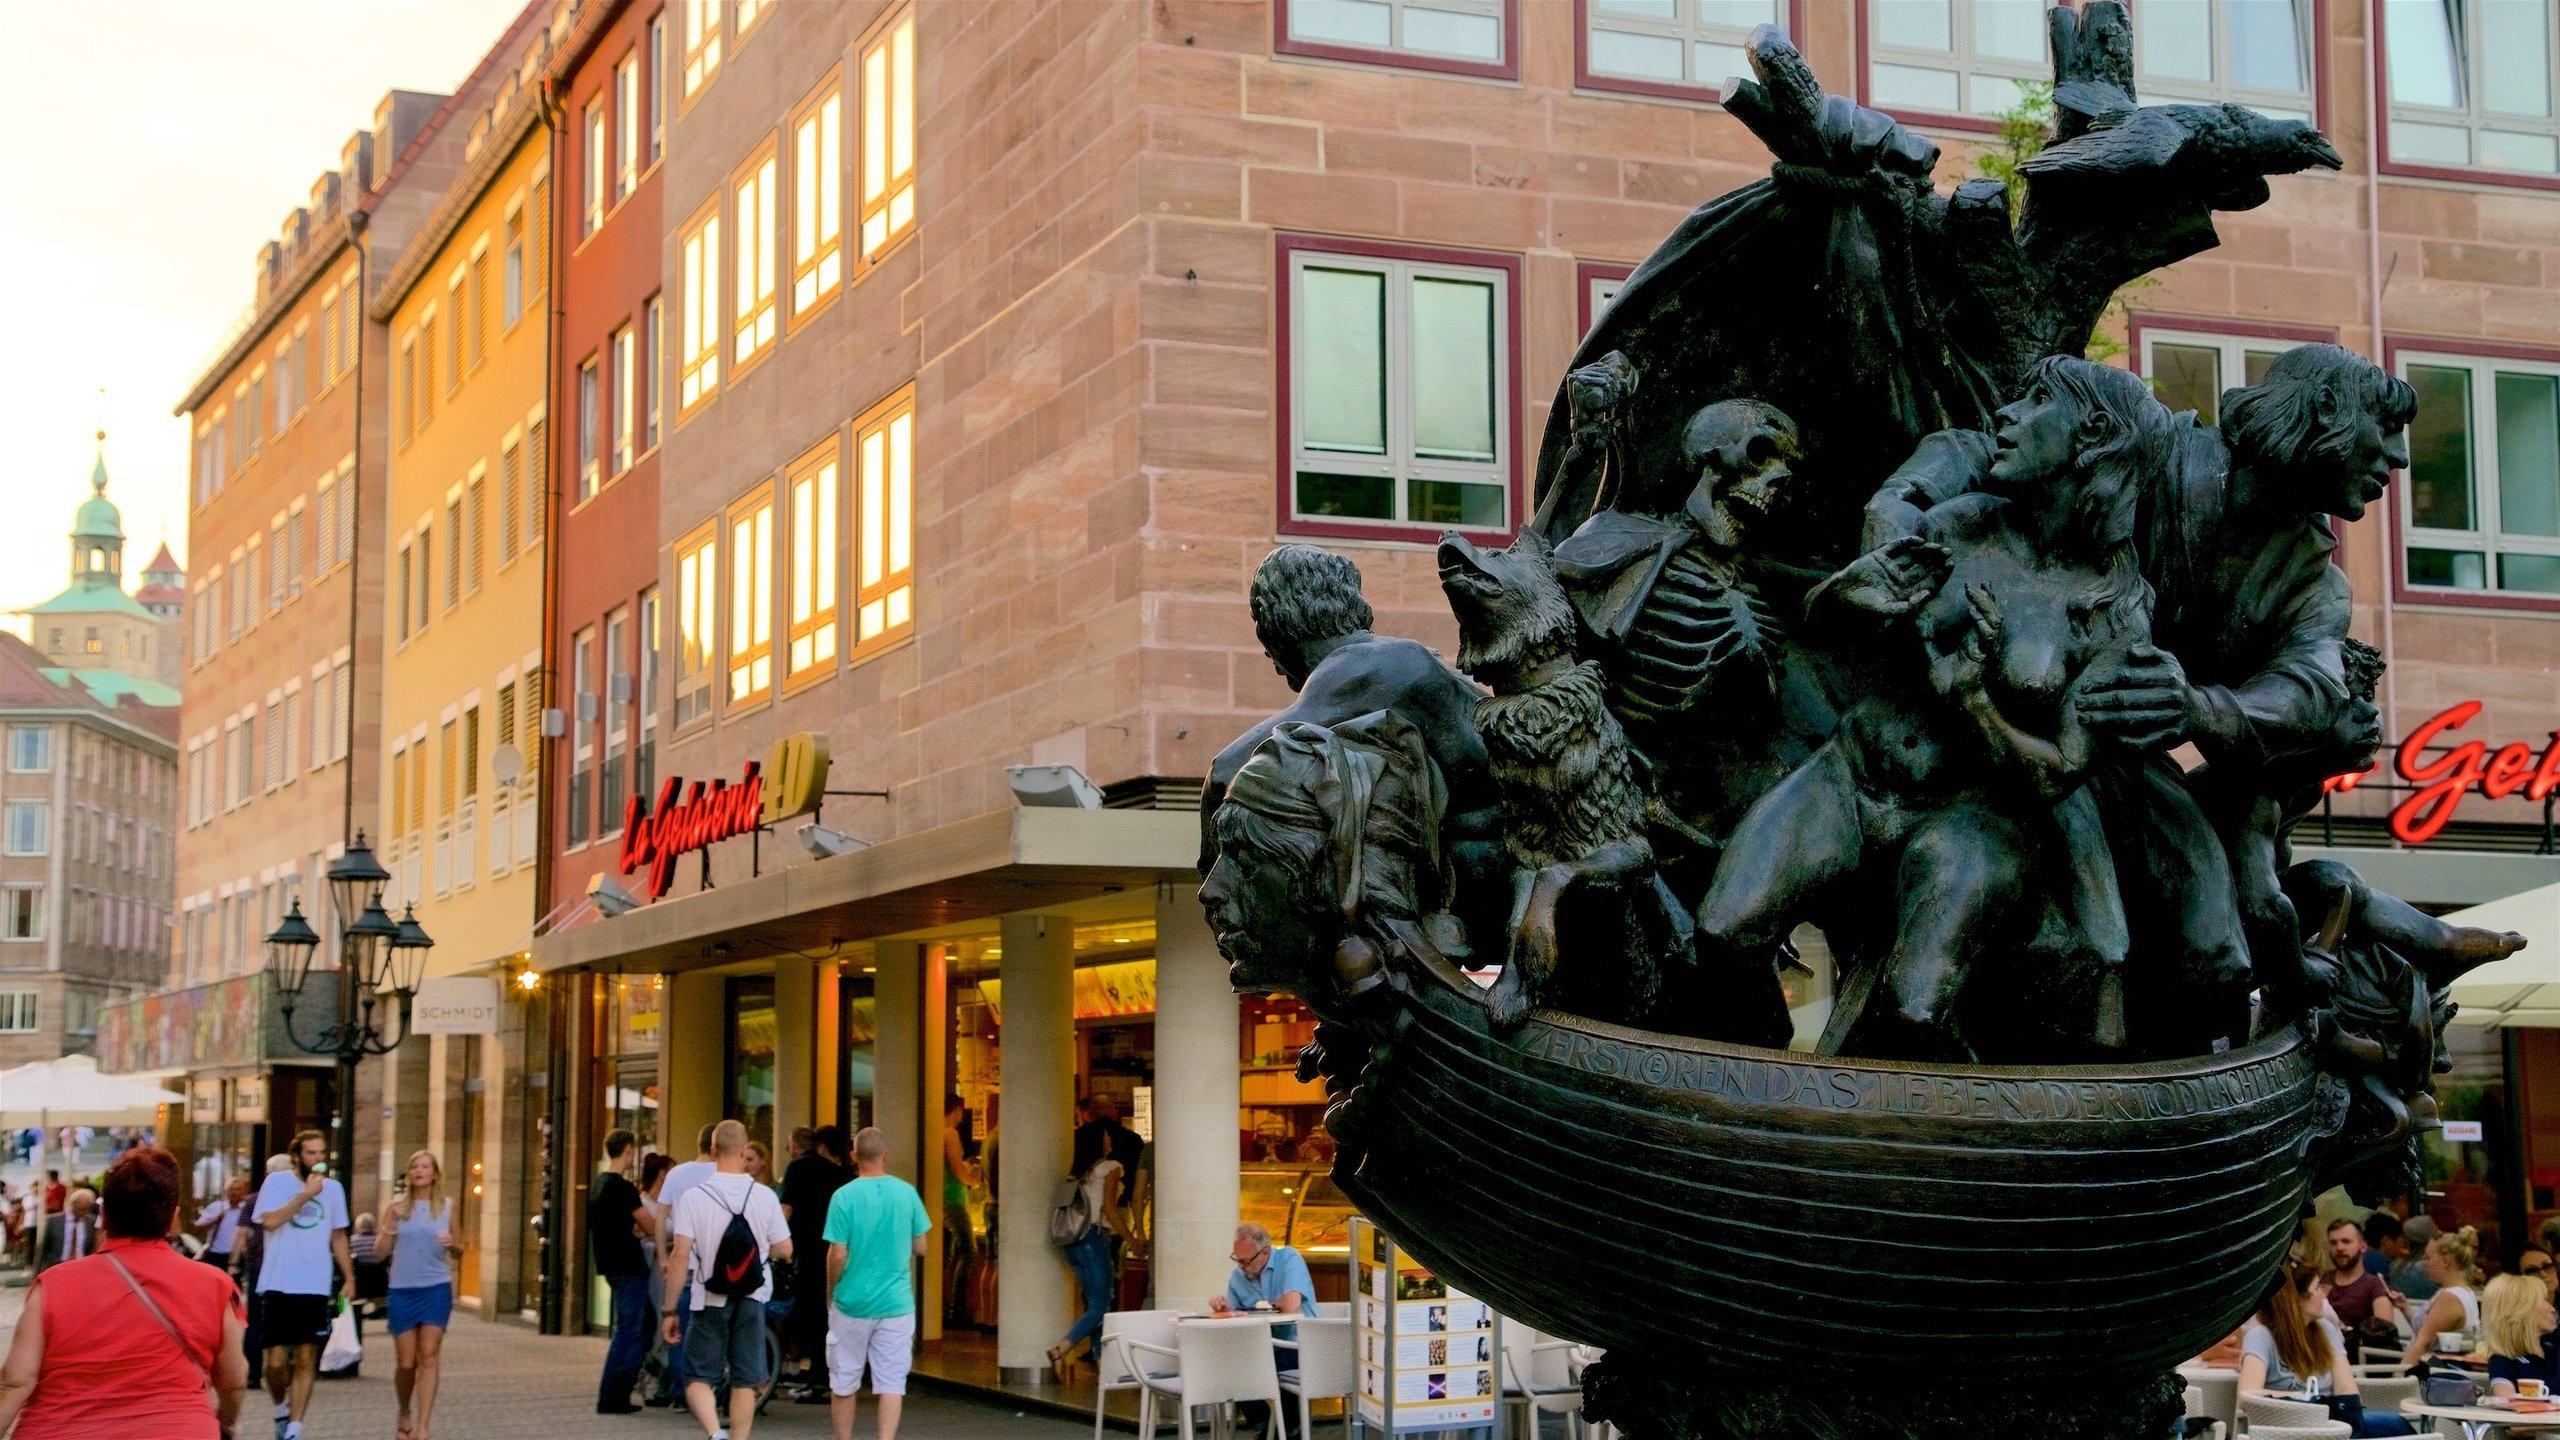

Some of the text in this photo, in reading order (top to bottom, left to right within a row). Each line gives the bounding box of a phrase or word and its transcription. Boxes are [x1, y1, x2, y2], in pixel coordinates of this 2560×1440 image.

[649, 759, 765, 899] Gelateria
[420, 1006, 495, 1019] SCHMIDT
[1765, 1061, 1860, 1108] DAS
[2040, 1080, 2133, 1121] DER
